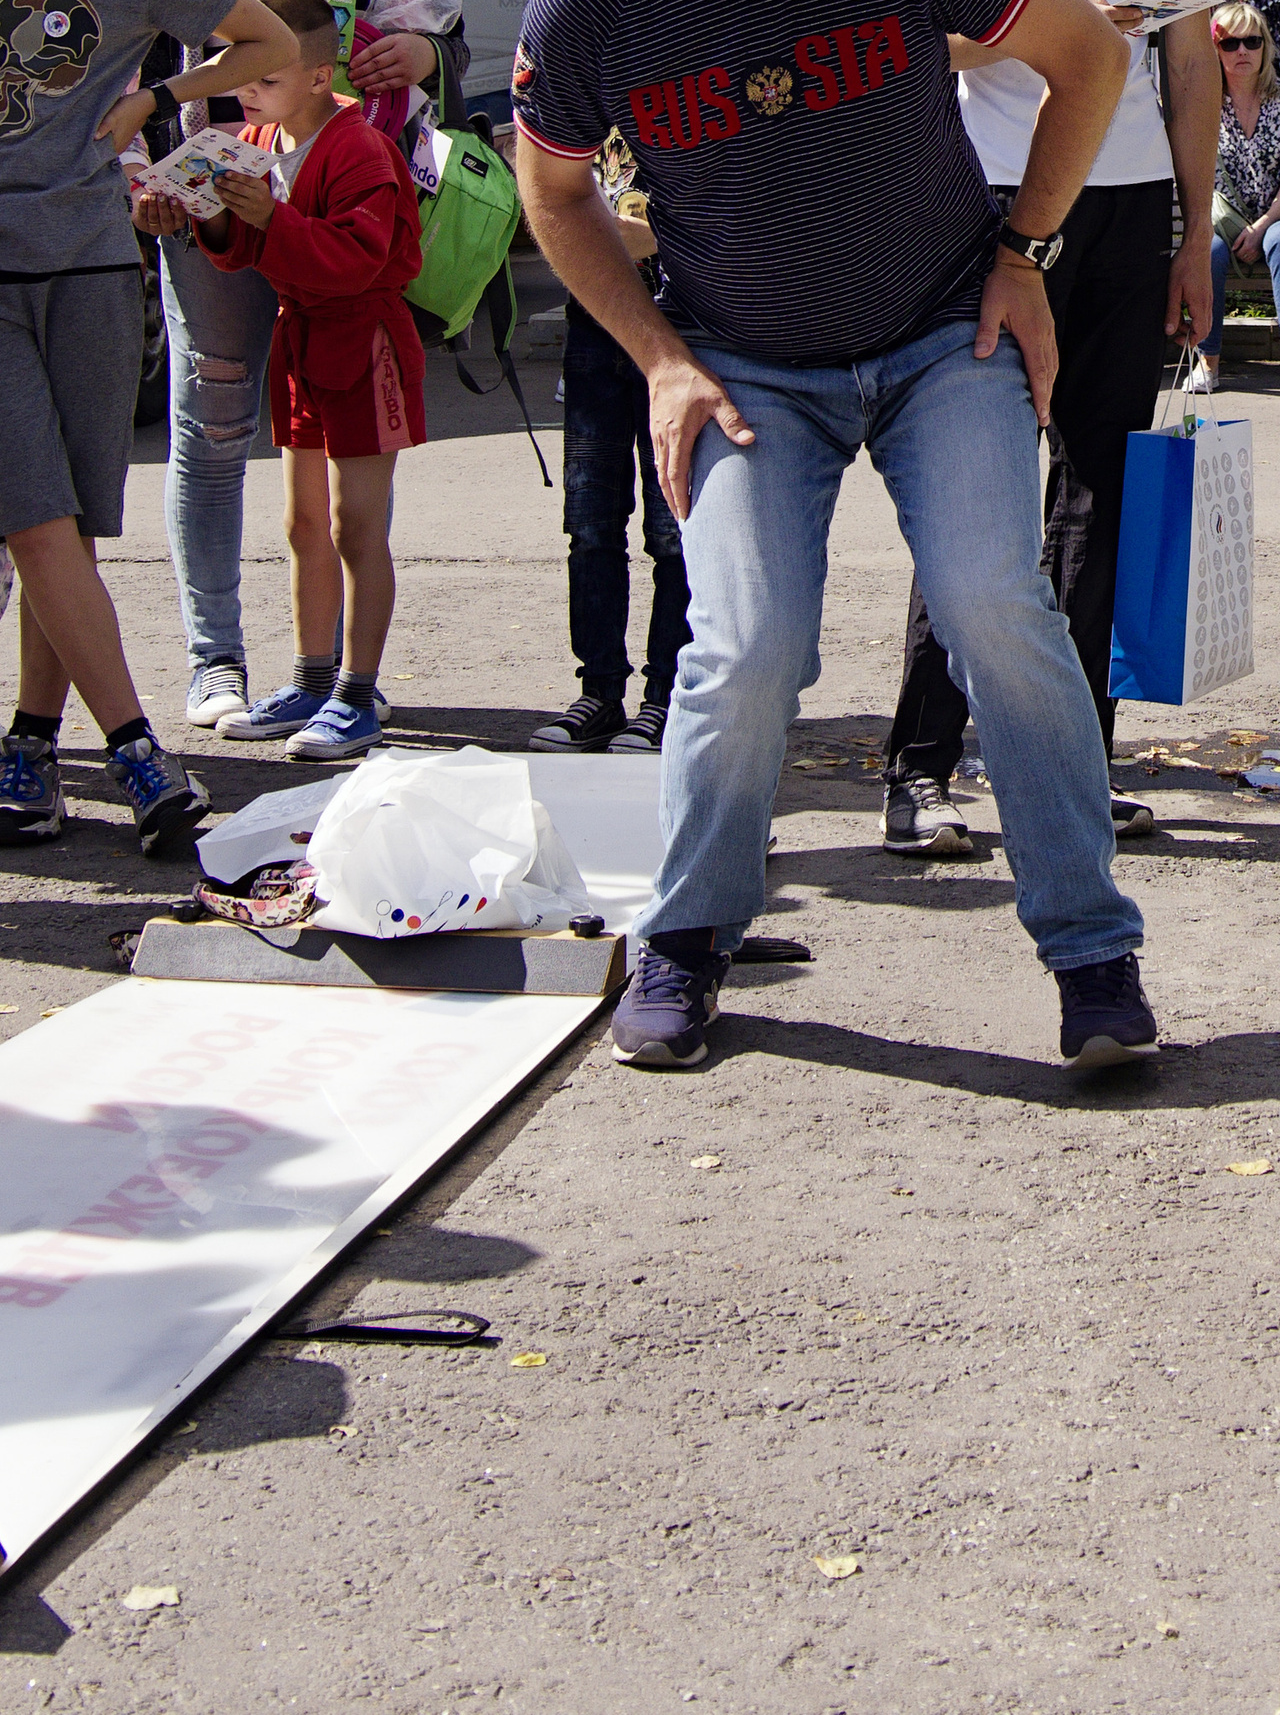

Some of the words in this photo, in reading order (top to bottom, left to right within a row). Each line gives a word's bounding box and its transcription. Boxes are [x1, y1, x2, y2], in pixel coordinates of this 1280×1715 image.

[366, 97, 380, 126] TORNE
[628, 66, 742, 150] RUS
[794, 14, 910, 112] SIA
[409, 158, 438, 188] ando
[70, 1011, 282, 1134] РОССИИ
